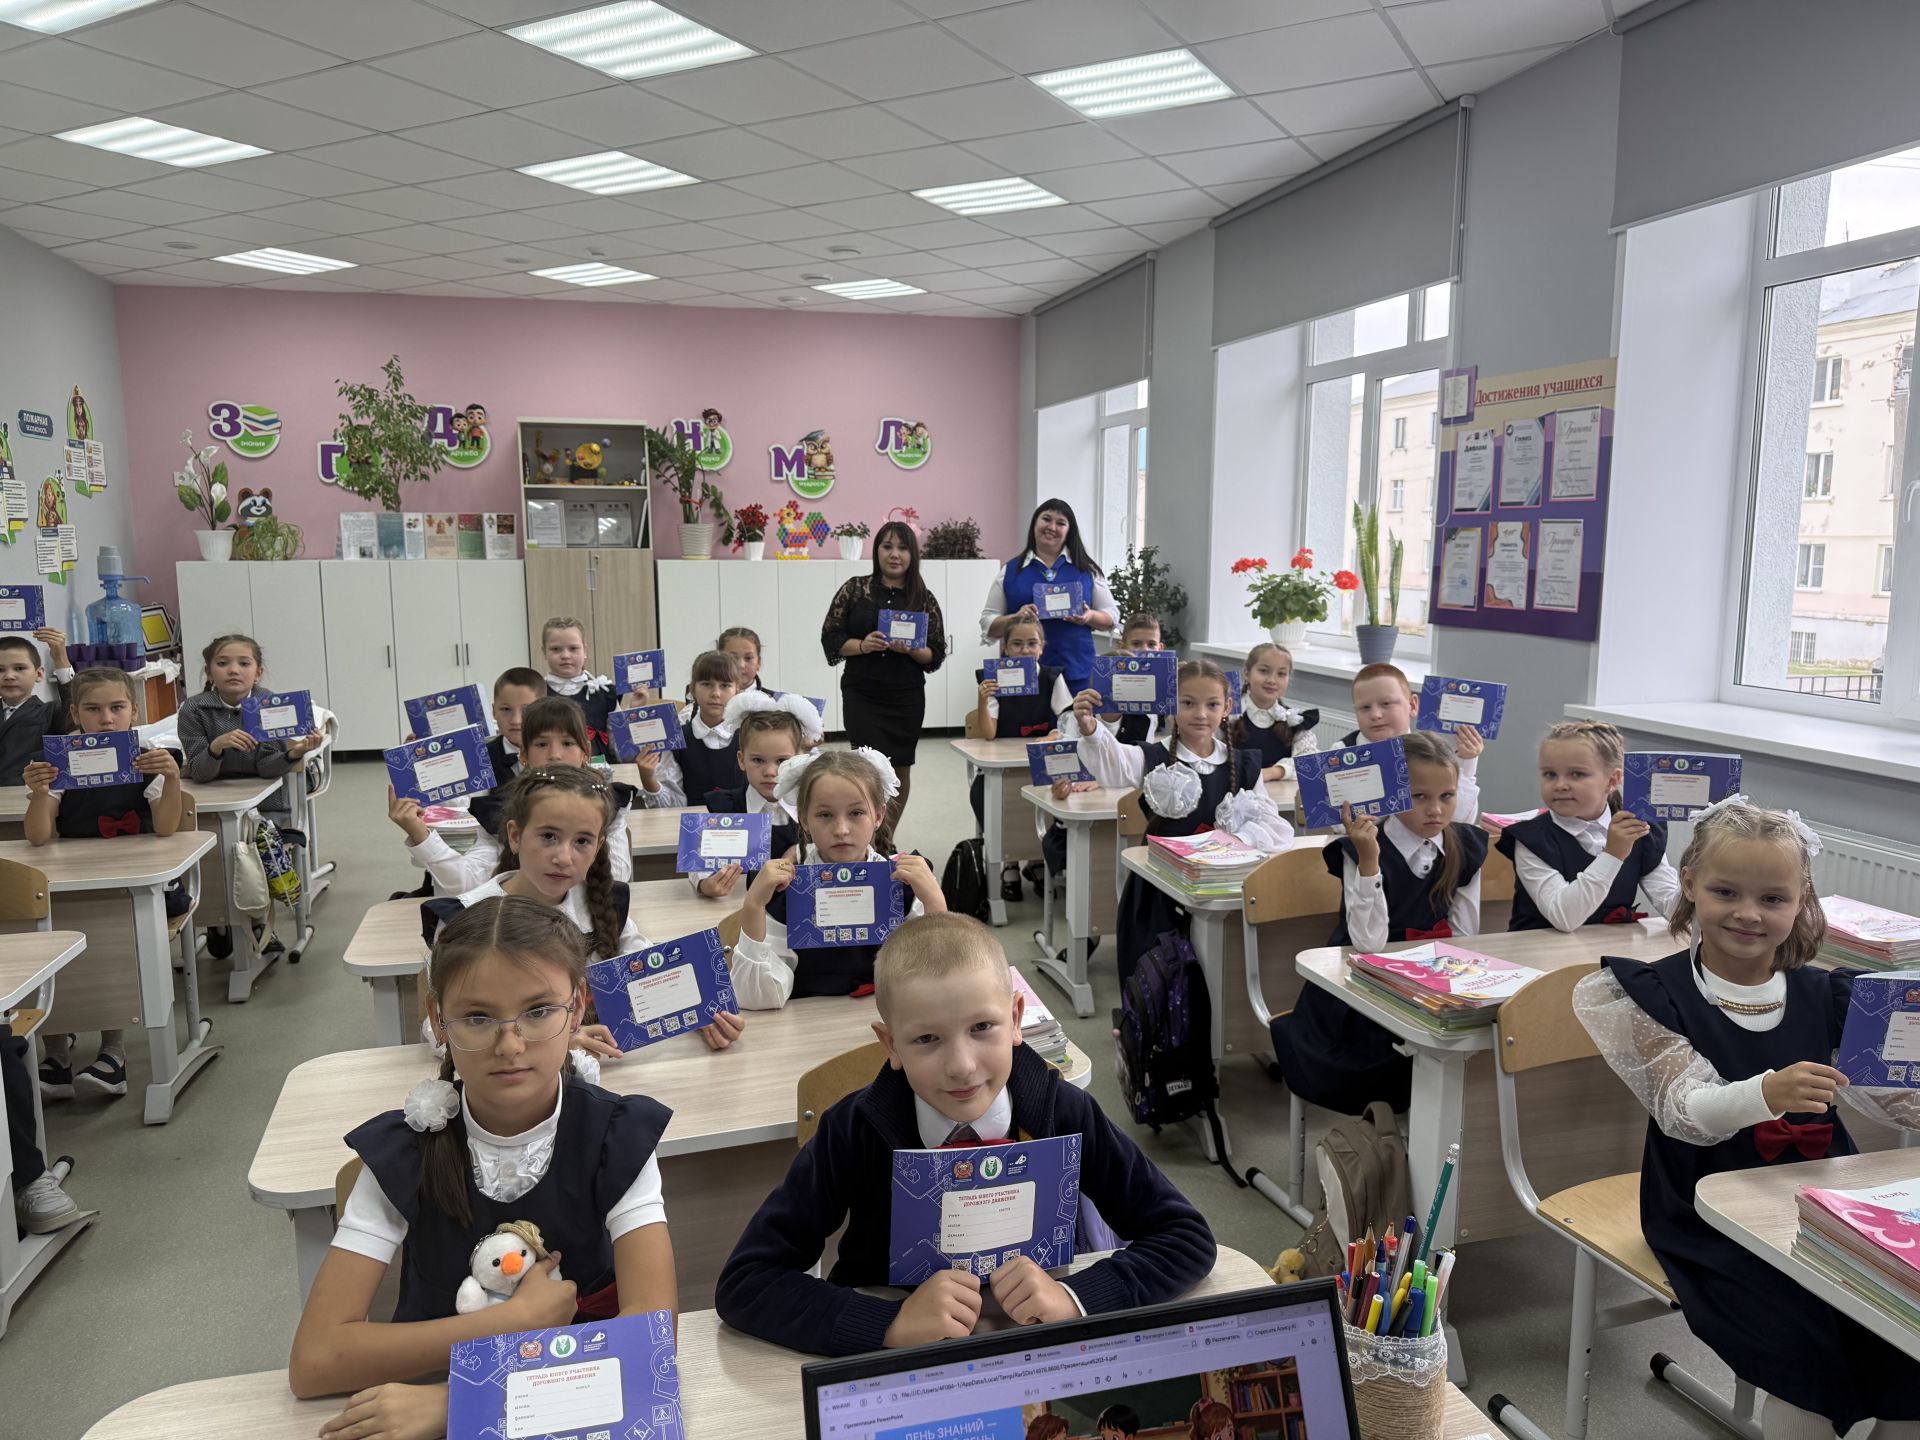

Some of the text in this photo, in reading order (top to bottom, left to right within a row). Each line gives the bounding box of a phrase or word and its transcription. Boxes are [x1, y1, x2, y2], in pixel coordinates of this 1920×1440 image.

[1475, 374, 1603, 406] Достижения учащихся
[23, 413, 48, 426] ПОЖАРНАЯ
[211, 403, 242, 437] З
[772, 446, 806, 478] М
[526, 1365, 600, 1381] ТЕТРАДЬ ЮНОГО УЧАСТНИКА
[532, 1377, 565, 1387] ДОРОЖНОГО
[565, 1372, 596, 1382] ДВИЖЕНИЯ
[937, 1418, 984, 1438] ЗНАНИЙ
